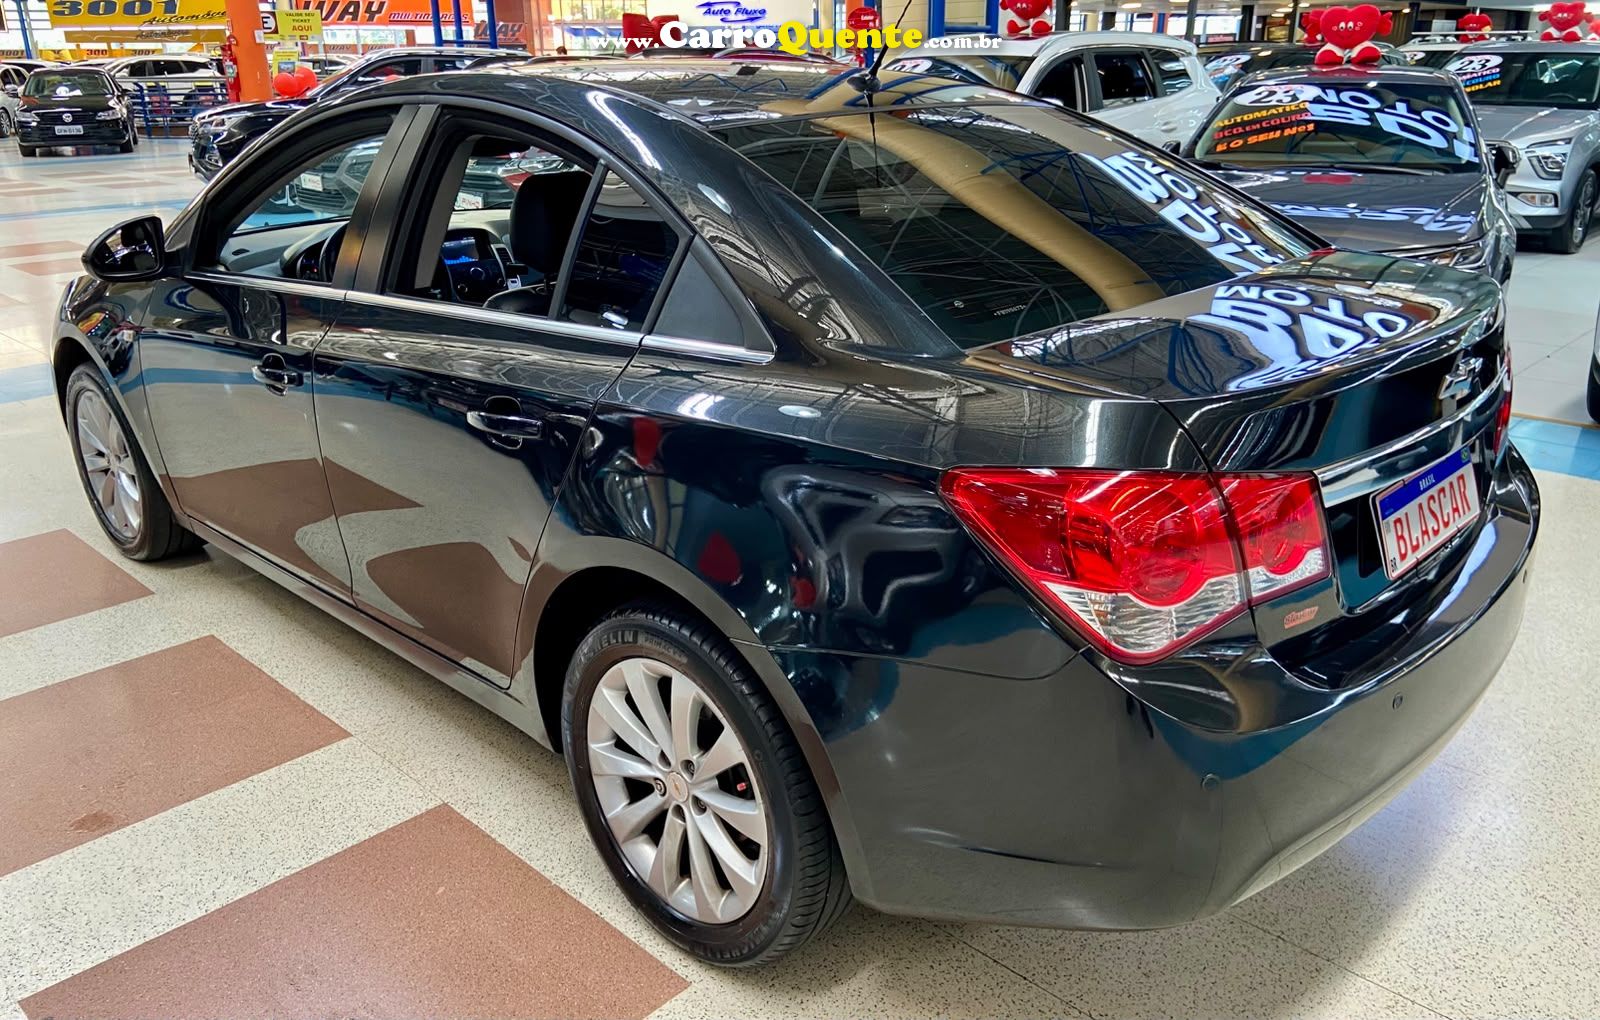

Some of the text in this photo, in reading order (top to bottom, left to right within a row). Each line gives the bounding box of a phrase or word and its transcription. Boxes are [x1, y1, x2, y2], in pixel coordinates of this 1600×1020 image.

[53, 0, 178, 16] 3001
[703, 7, 767, 16] Auto Fluxo
[1419, 473, 1436, 491] BRASIL
[1393, 474, 1471, 561] BLASCAR
